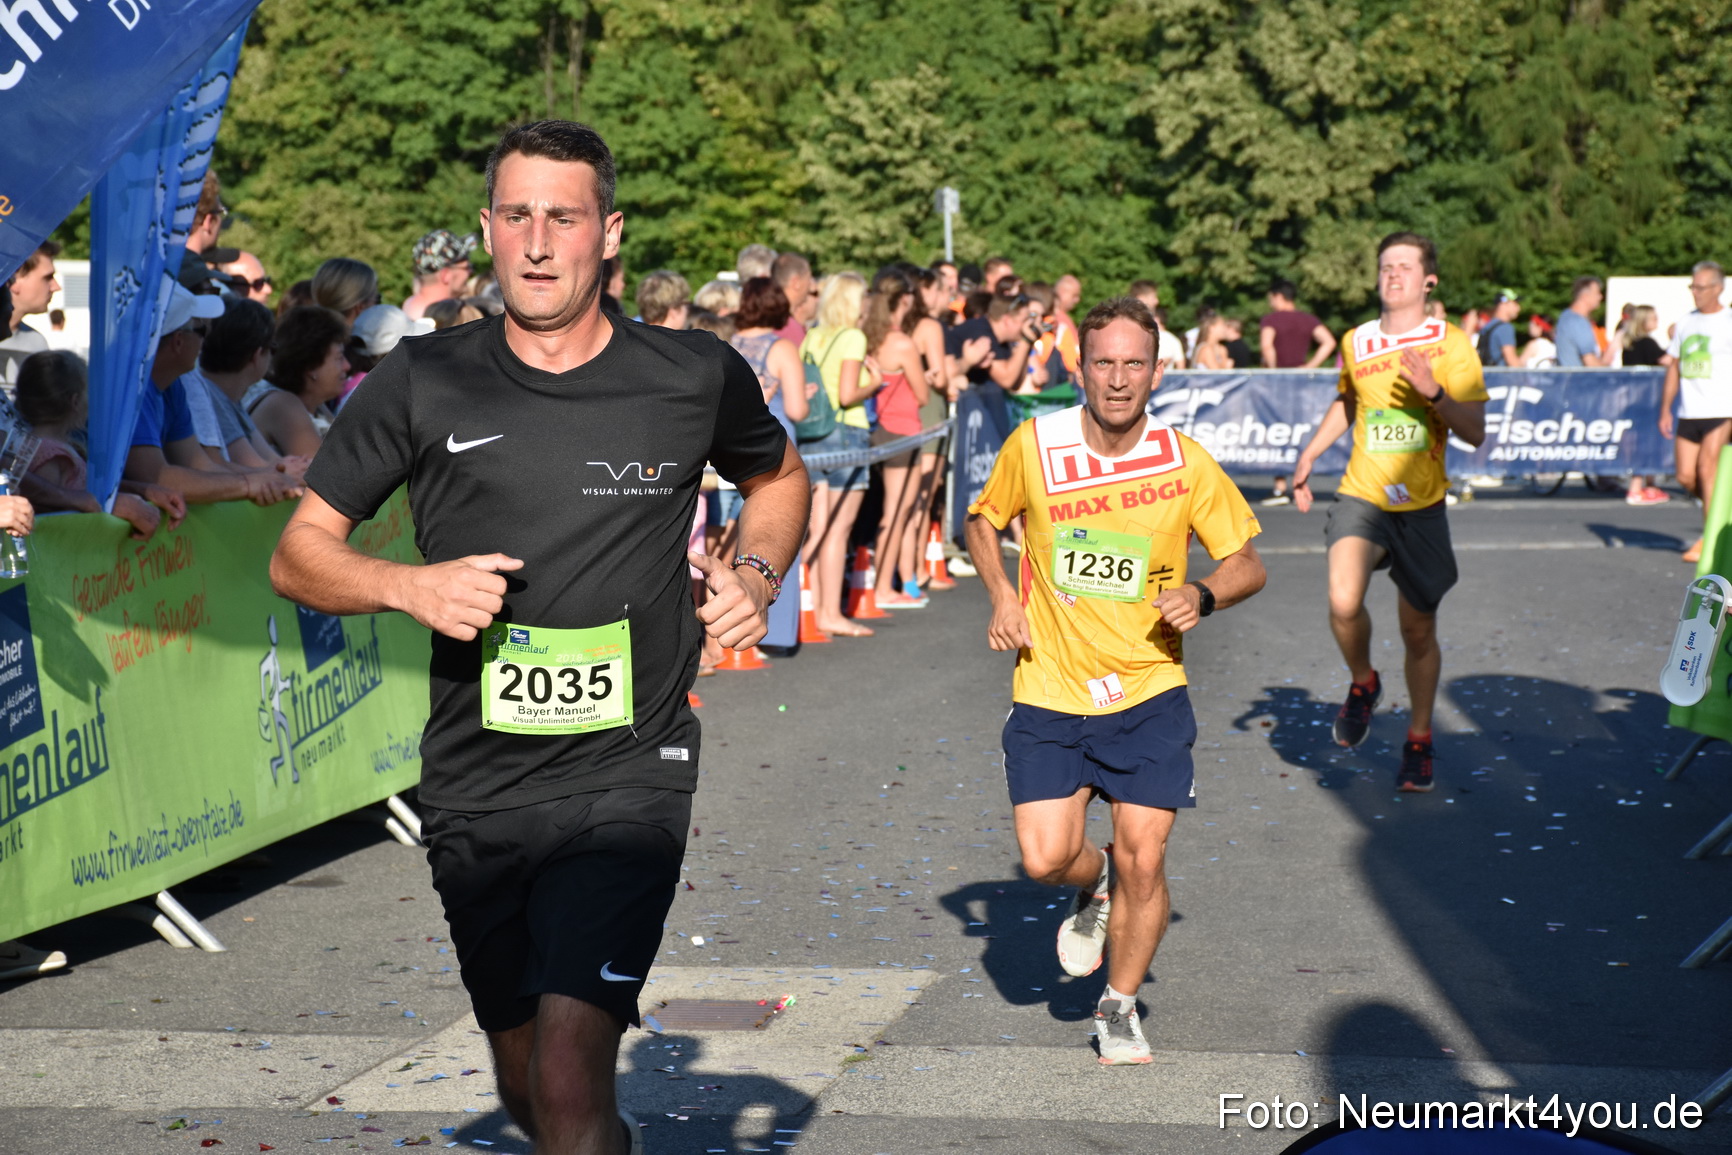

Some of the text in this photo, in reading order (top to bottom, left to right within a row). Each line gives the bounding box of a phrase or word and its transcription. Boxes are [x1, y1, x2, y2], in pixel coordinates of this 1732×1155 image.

[1355, 359, 1393, 380] MAX
[1372, 425, 1417, 441] 1287
[1485, 411, 1633, 444] Fischer
[1212, 446, 1298, 463] OMOBILE
[1489, 446, 1619, 461] AUTOMOBILE
[582, 487, 674, 496] VISUAL UNLIMITED
[1049, 479, 1190, 523] MAX BÖGL
[1063, 551, 1134, 582] 1236
[1068, 575, 1125, 590] Schmid Michael
[1687, 631, 1697, 646] SDK
[290, 615, 382, 744] firmenlauf
[499, 663, 613, 704] 2035
[512, 716, 536, 724] Visual
[537, 717, 574, 725] Unlimited
[576, 714, 601, 723] GmbH
[518, 704, 596, 718] Bayer Manuel
[301, 720, 347, 770] neumarkt
